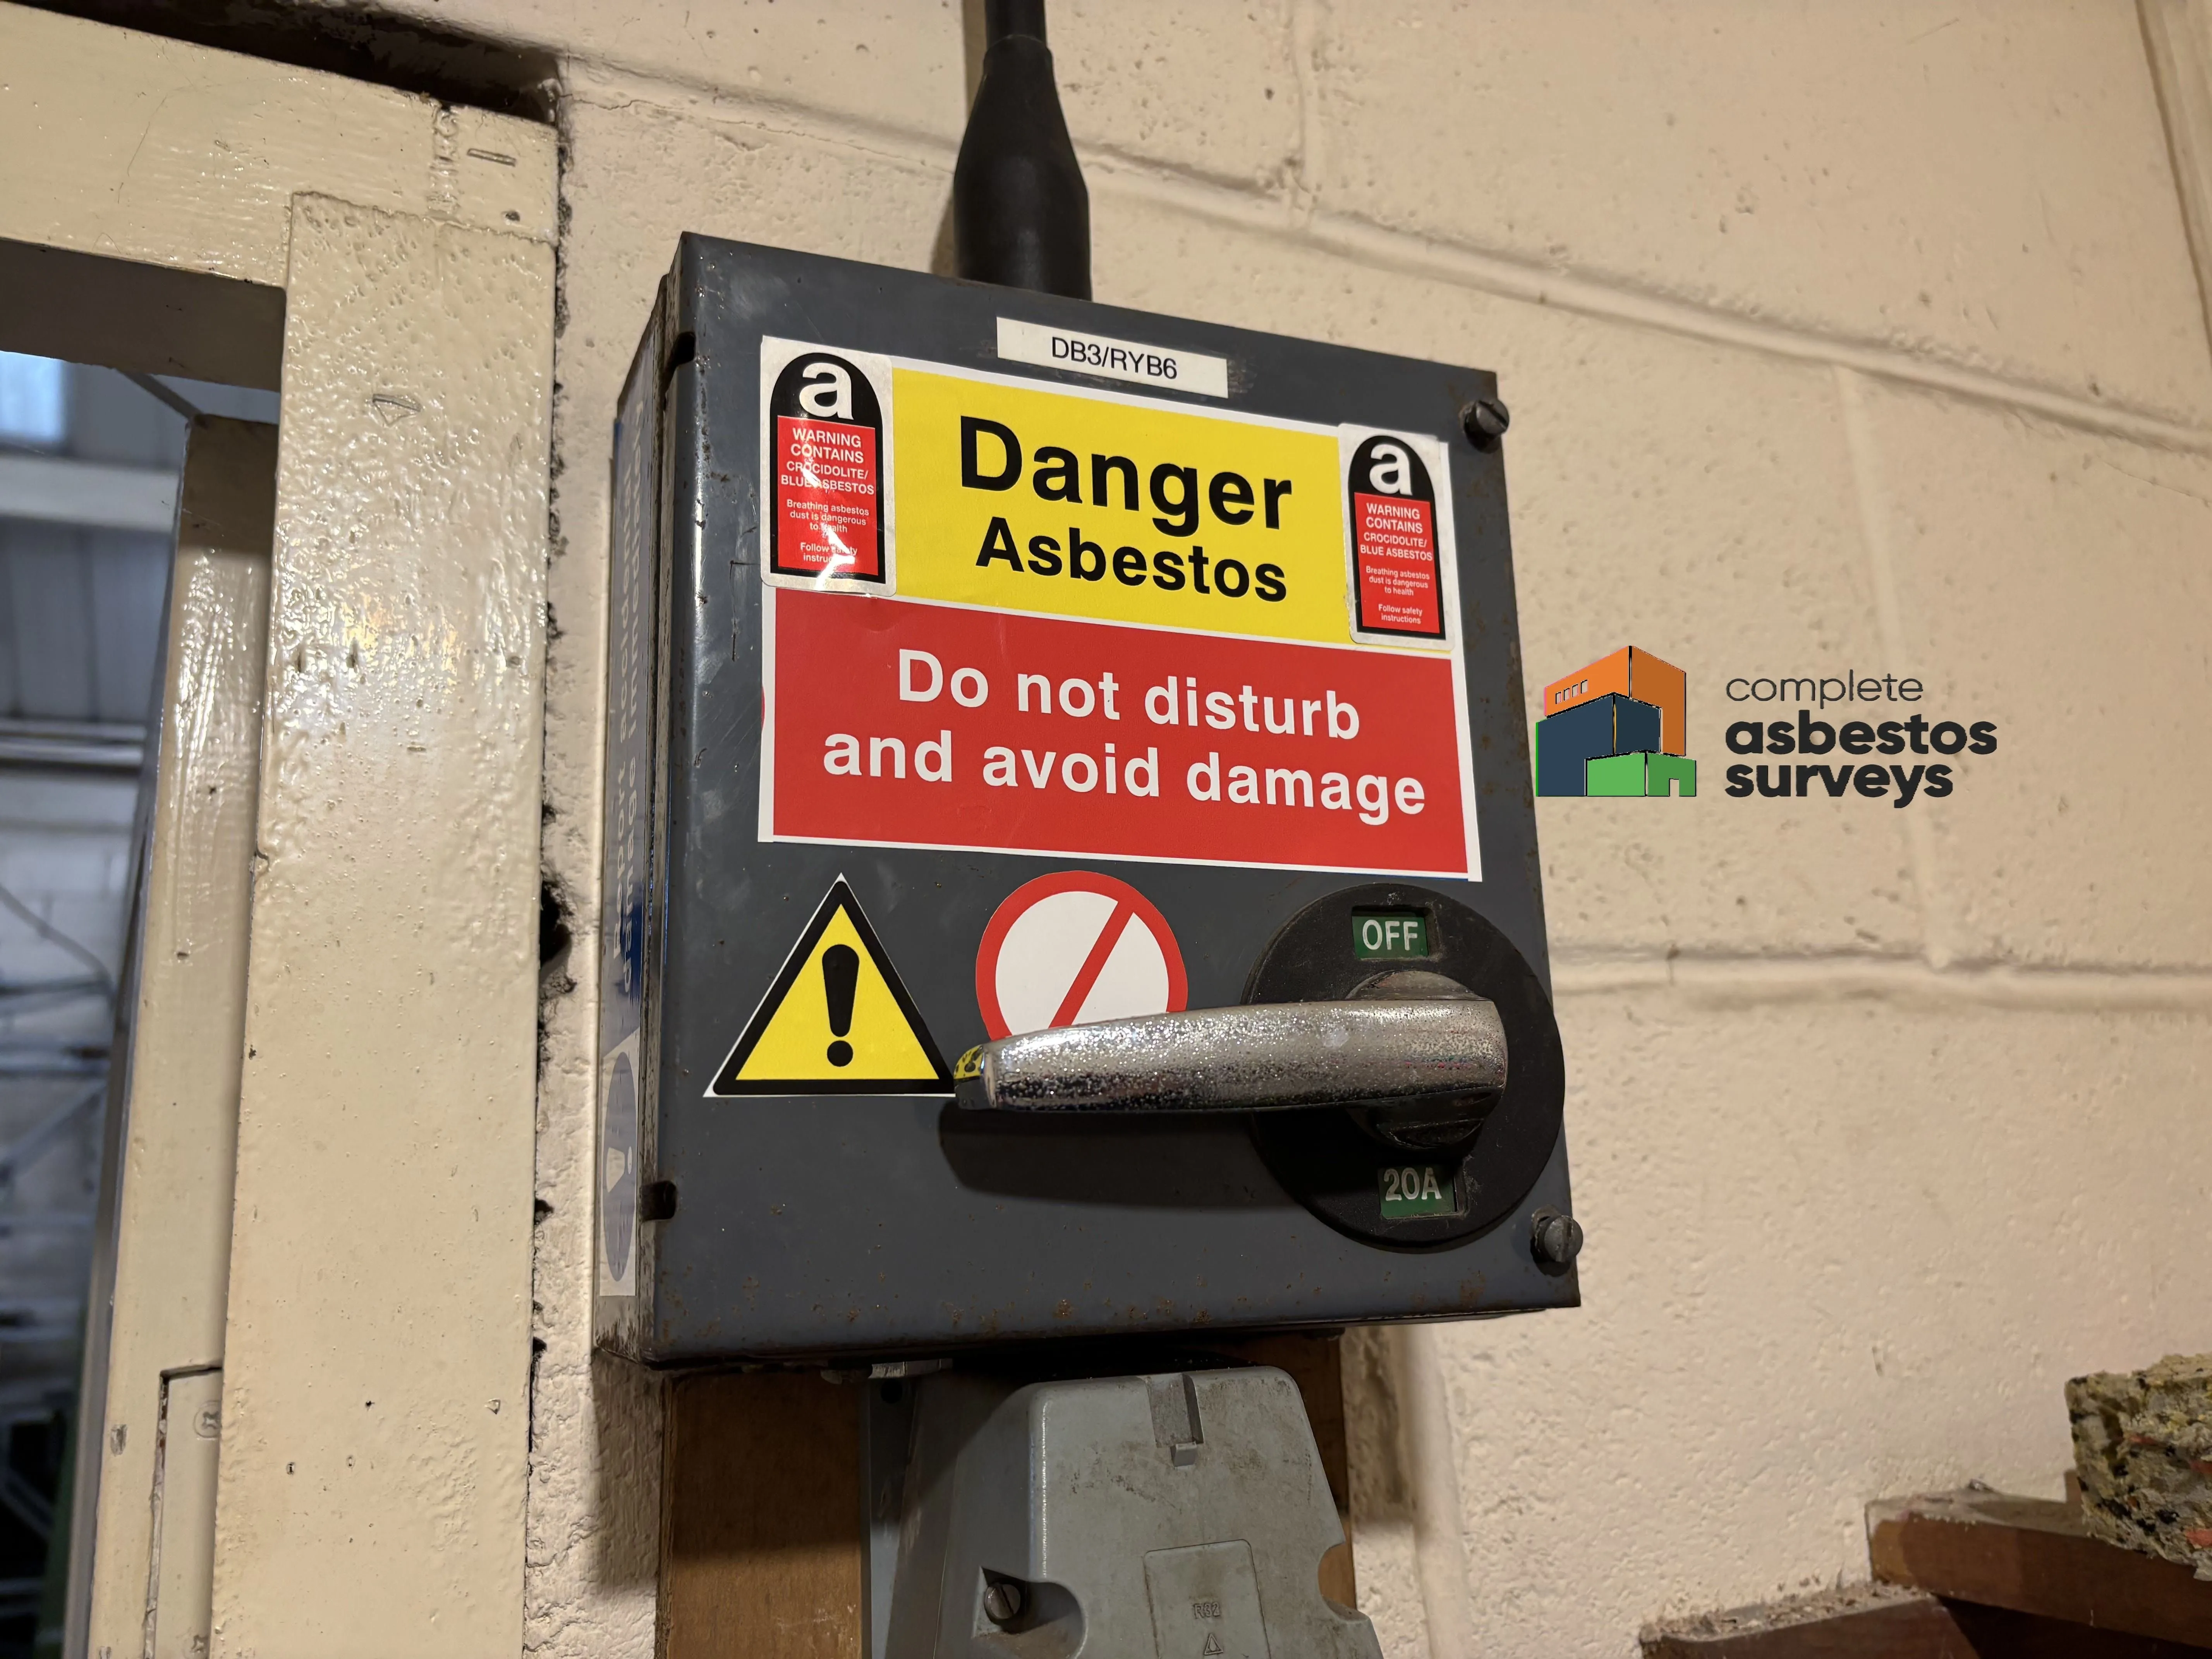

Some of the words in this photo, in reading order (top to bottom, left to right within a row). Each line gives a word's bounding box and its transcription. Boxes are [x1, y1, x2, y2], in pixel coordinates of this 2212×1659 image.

[1052, 337, 1177, 379] DB3/RYB6
[793, 428, 861, 448] WARNING
[791, 444, 864, 463] CONTAINS
[787, 461, 868, 479] CROCIDOLITE/
[961, 416, 1292, 537] Danger
[781, 475, 811, 487] BLUE
[787, 499, 828, 512] Breathing
[831, 504, 869, 516] asbestos
[1366, 503, 1420, 520] WARNING
[790, 510, 809, 520] dust
[811, 512, 819, 520] is
[821, 514, 866, 525] dangerous
[1366, 517, 1423, 534] CONTAINS
[821, 523, 847, 532] alth
[1364, 532, 1427, 548] CROCIDOLITE/
[800, 543, 830, 552] Follow
[831, 546, 857, 555] saty
[1360, 544, 1384, 556] BLUE
[1386, 547, 1432, 561] ASBESTOS
[975, 516, 1287, 602] Asbestos
[629, 400, 644, 738] immediately
[1366, 565, 1398, 577] Breathing
[1400, 570, 1430, 580] asbestos
[1369, 575, 1384, 584] dust
[1393, 579, 1428, 588] dangerous
[1393, 587, 1413, 596] health
[1378, 604, 1401, 613] Follow
[1402, 607, 1422, 617] safety
[1381, 613, 1421, 624] instructions
[900, 649, 988, 708] Do
[1018, 672, 1120, 720] not
[1145, 676, 1359, 739] disturb
[613, 761, 625, 959] Report
[620, 463, 631, 743] accidental
[823, 730, 952, 782] and
[982, 743, 1159, 797] avoid
[1187, 752, 1425, 825] damage
[623, 756, 637, 993] damage
[1362, 919, 1418, 951] OFF
[1384, 1167, 1442, 1201] 20A
